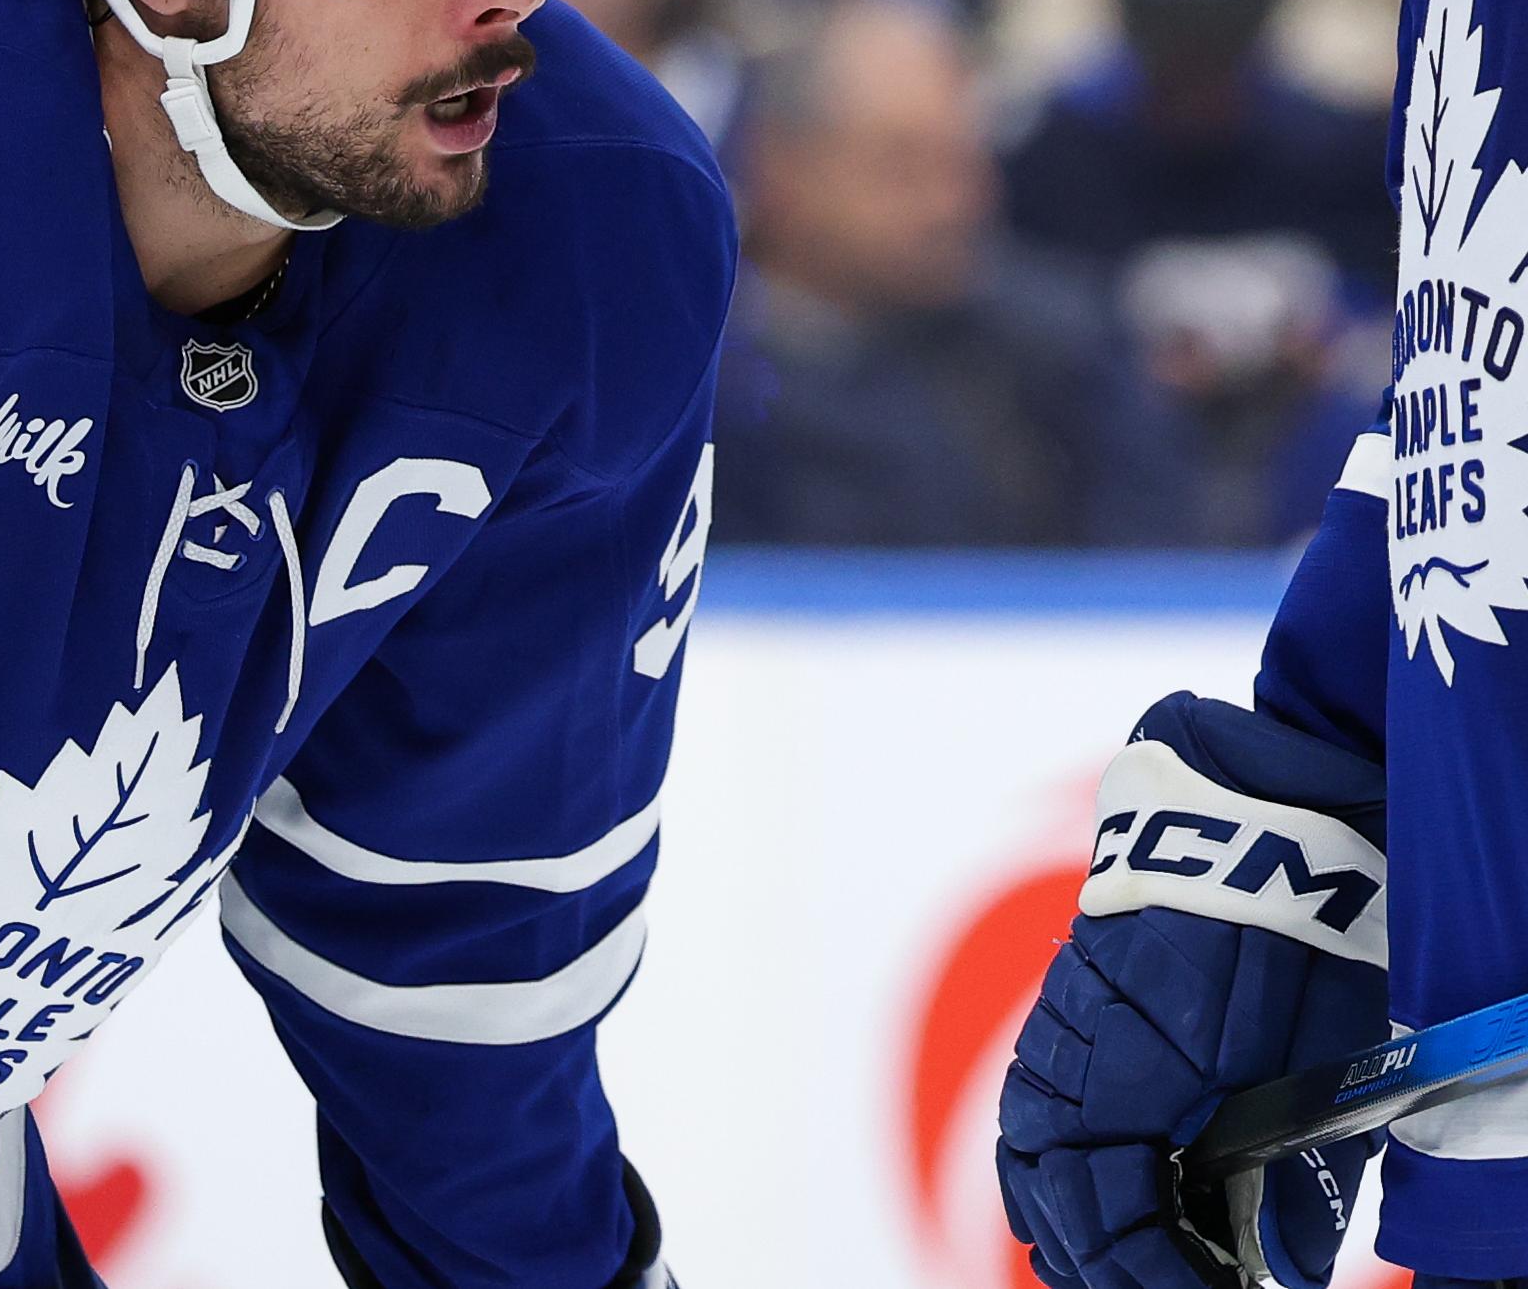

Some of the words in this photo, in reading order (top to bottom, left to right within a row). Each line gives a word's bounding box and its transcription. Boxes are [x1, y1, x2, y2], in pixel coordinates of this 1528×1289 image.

[197, 360, 240, 395] NHL
[308, 457, 492, 626] C
[1395, 458, 1486, 540] LEAFS
[1088, 809, 1382, 935] CCM
